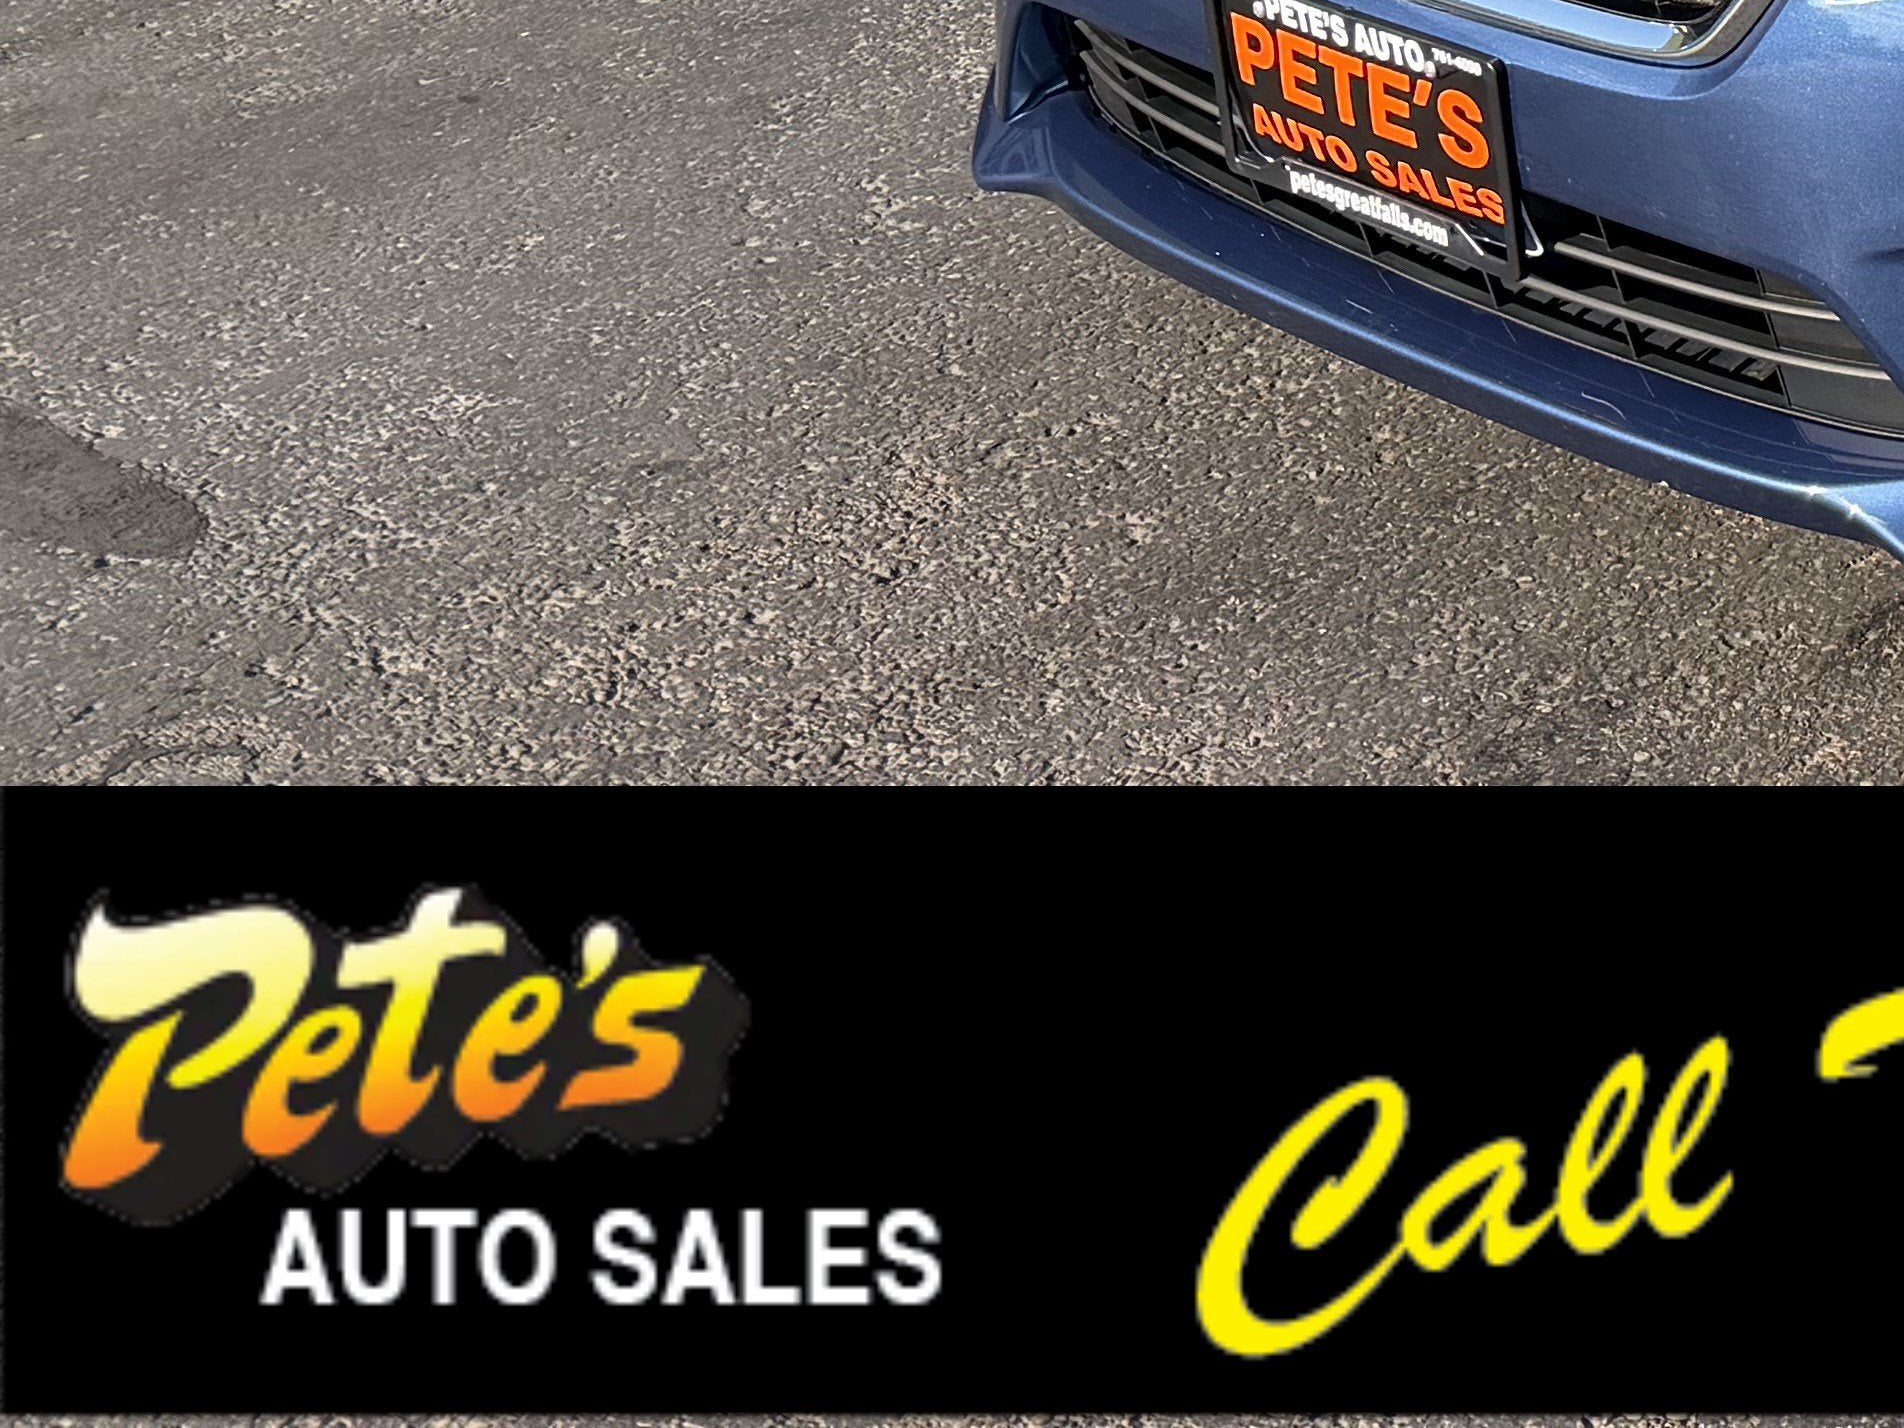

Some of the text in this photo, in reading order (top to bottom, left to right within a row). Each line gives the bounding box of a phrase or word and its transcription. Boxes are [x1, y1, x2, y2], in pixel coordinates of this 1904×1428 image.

[1230, 11, 1491, 170] PETE'S
[1354, 22, 1426, 73] AUTO
[1252, 102, 1506, 226] AUTO SALES
[1289, 171, 1450, 247] petesgreatfalls.com
